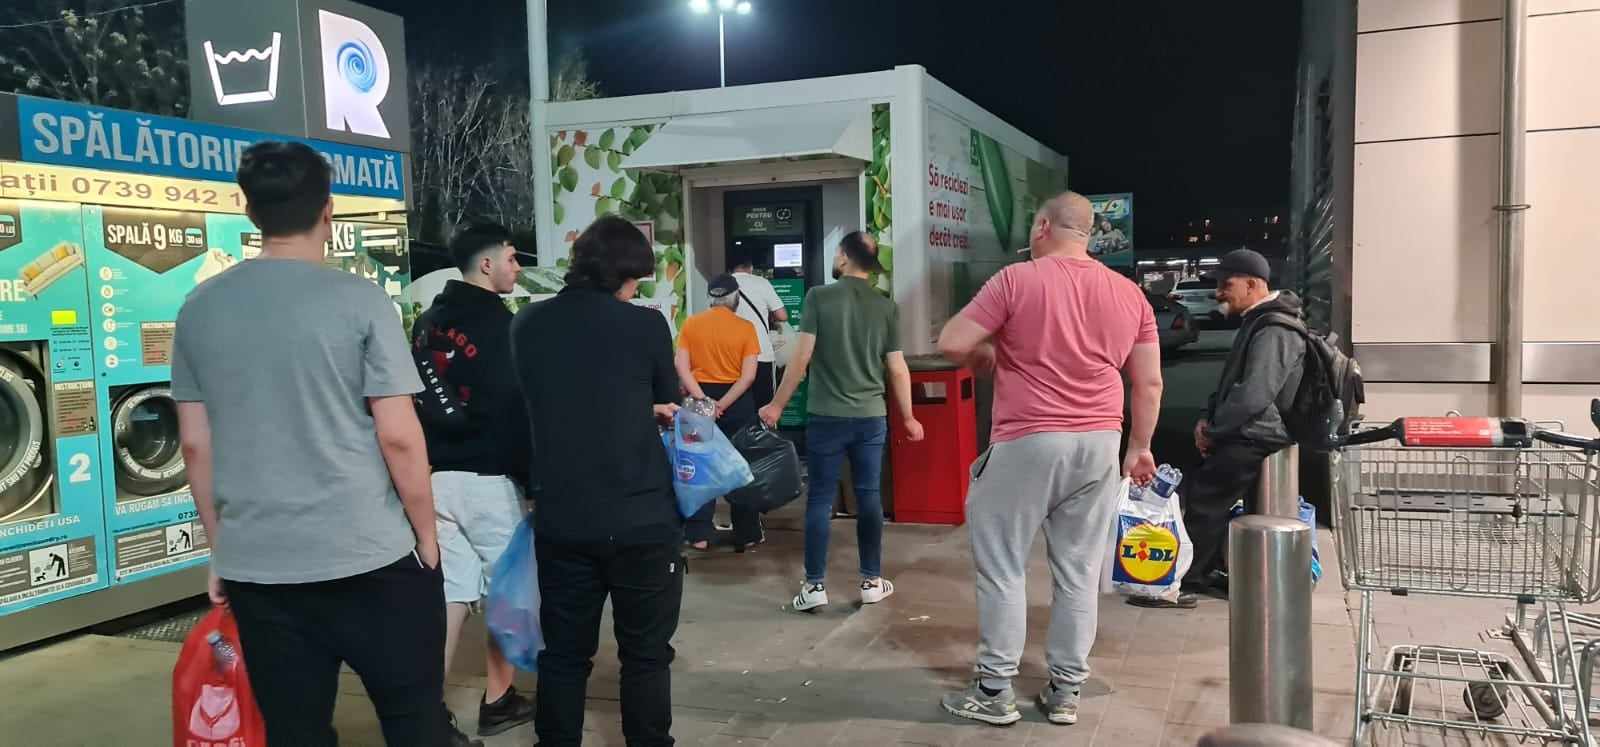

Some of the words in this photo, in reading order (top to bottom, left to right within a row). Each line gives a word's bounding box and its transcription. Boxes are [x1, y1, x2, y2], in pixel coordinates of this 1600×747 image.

[72, 176, 152, 199] 0739
[164, 186, 218, 205] 942
[107, 221, 152, 245] SPALĂ
[153, 223, 167, 250] 9
[168, 228, 184, 244] KG
[331, 222, 355, 251] KG
[69, 452, 91, 483] 2
